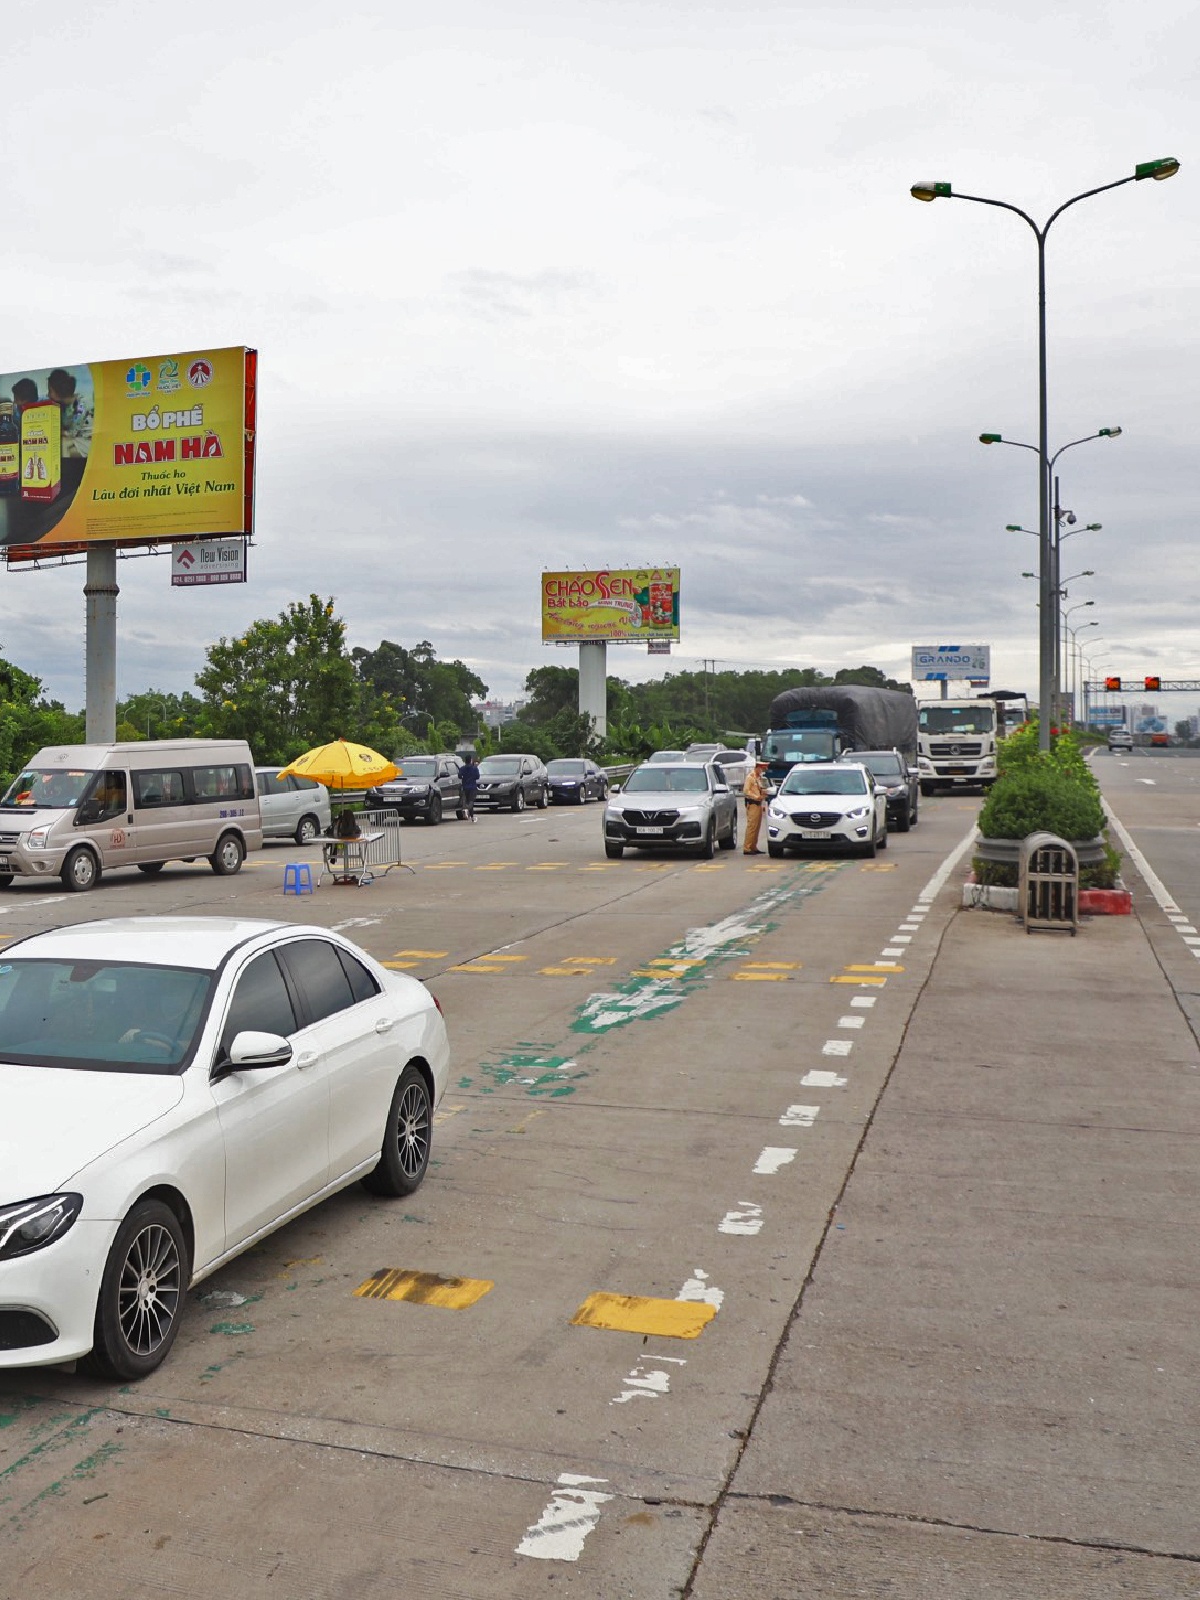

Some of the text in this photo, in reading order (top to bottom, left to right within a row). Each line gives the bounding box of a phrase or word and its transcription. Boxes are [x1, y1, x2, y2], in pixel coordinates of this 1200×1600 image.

[113, 428, 224, 466] NAM HÀ
[141, 469, 186, 481] Thuốc ho
[92, 480, 236, 501] Lâu đời nhất Việt Nam
[200, 547, 239, 563] New Vision
[919, 655, 971, 664] GRANDO
